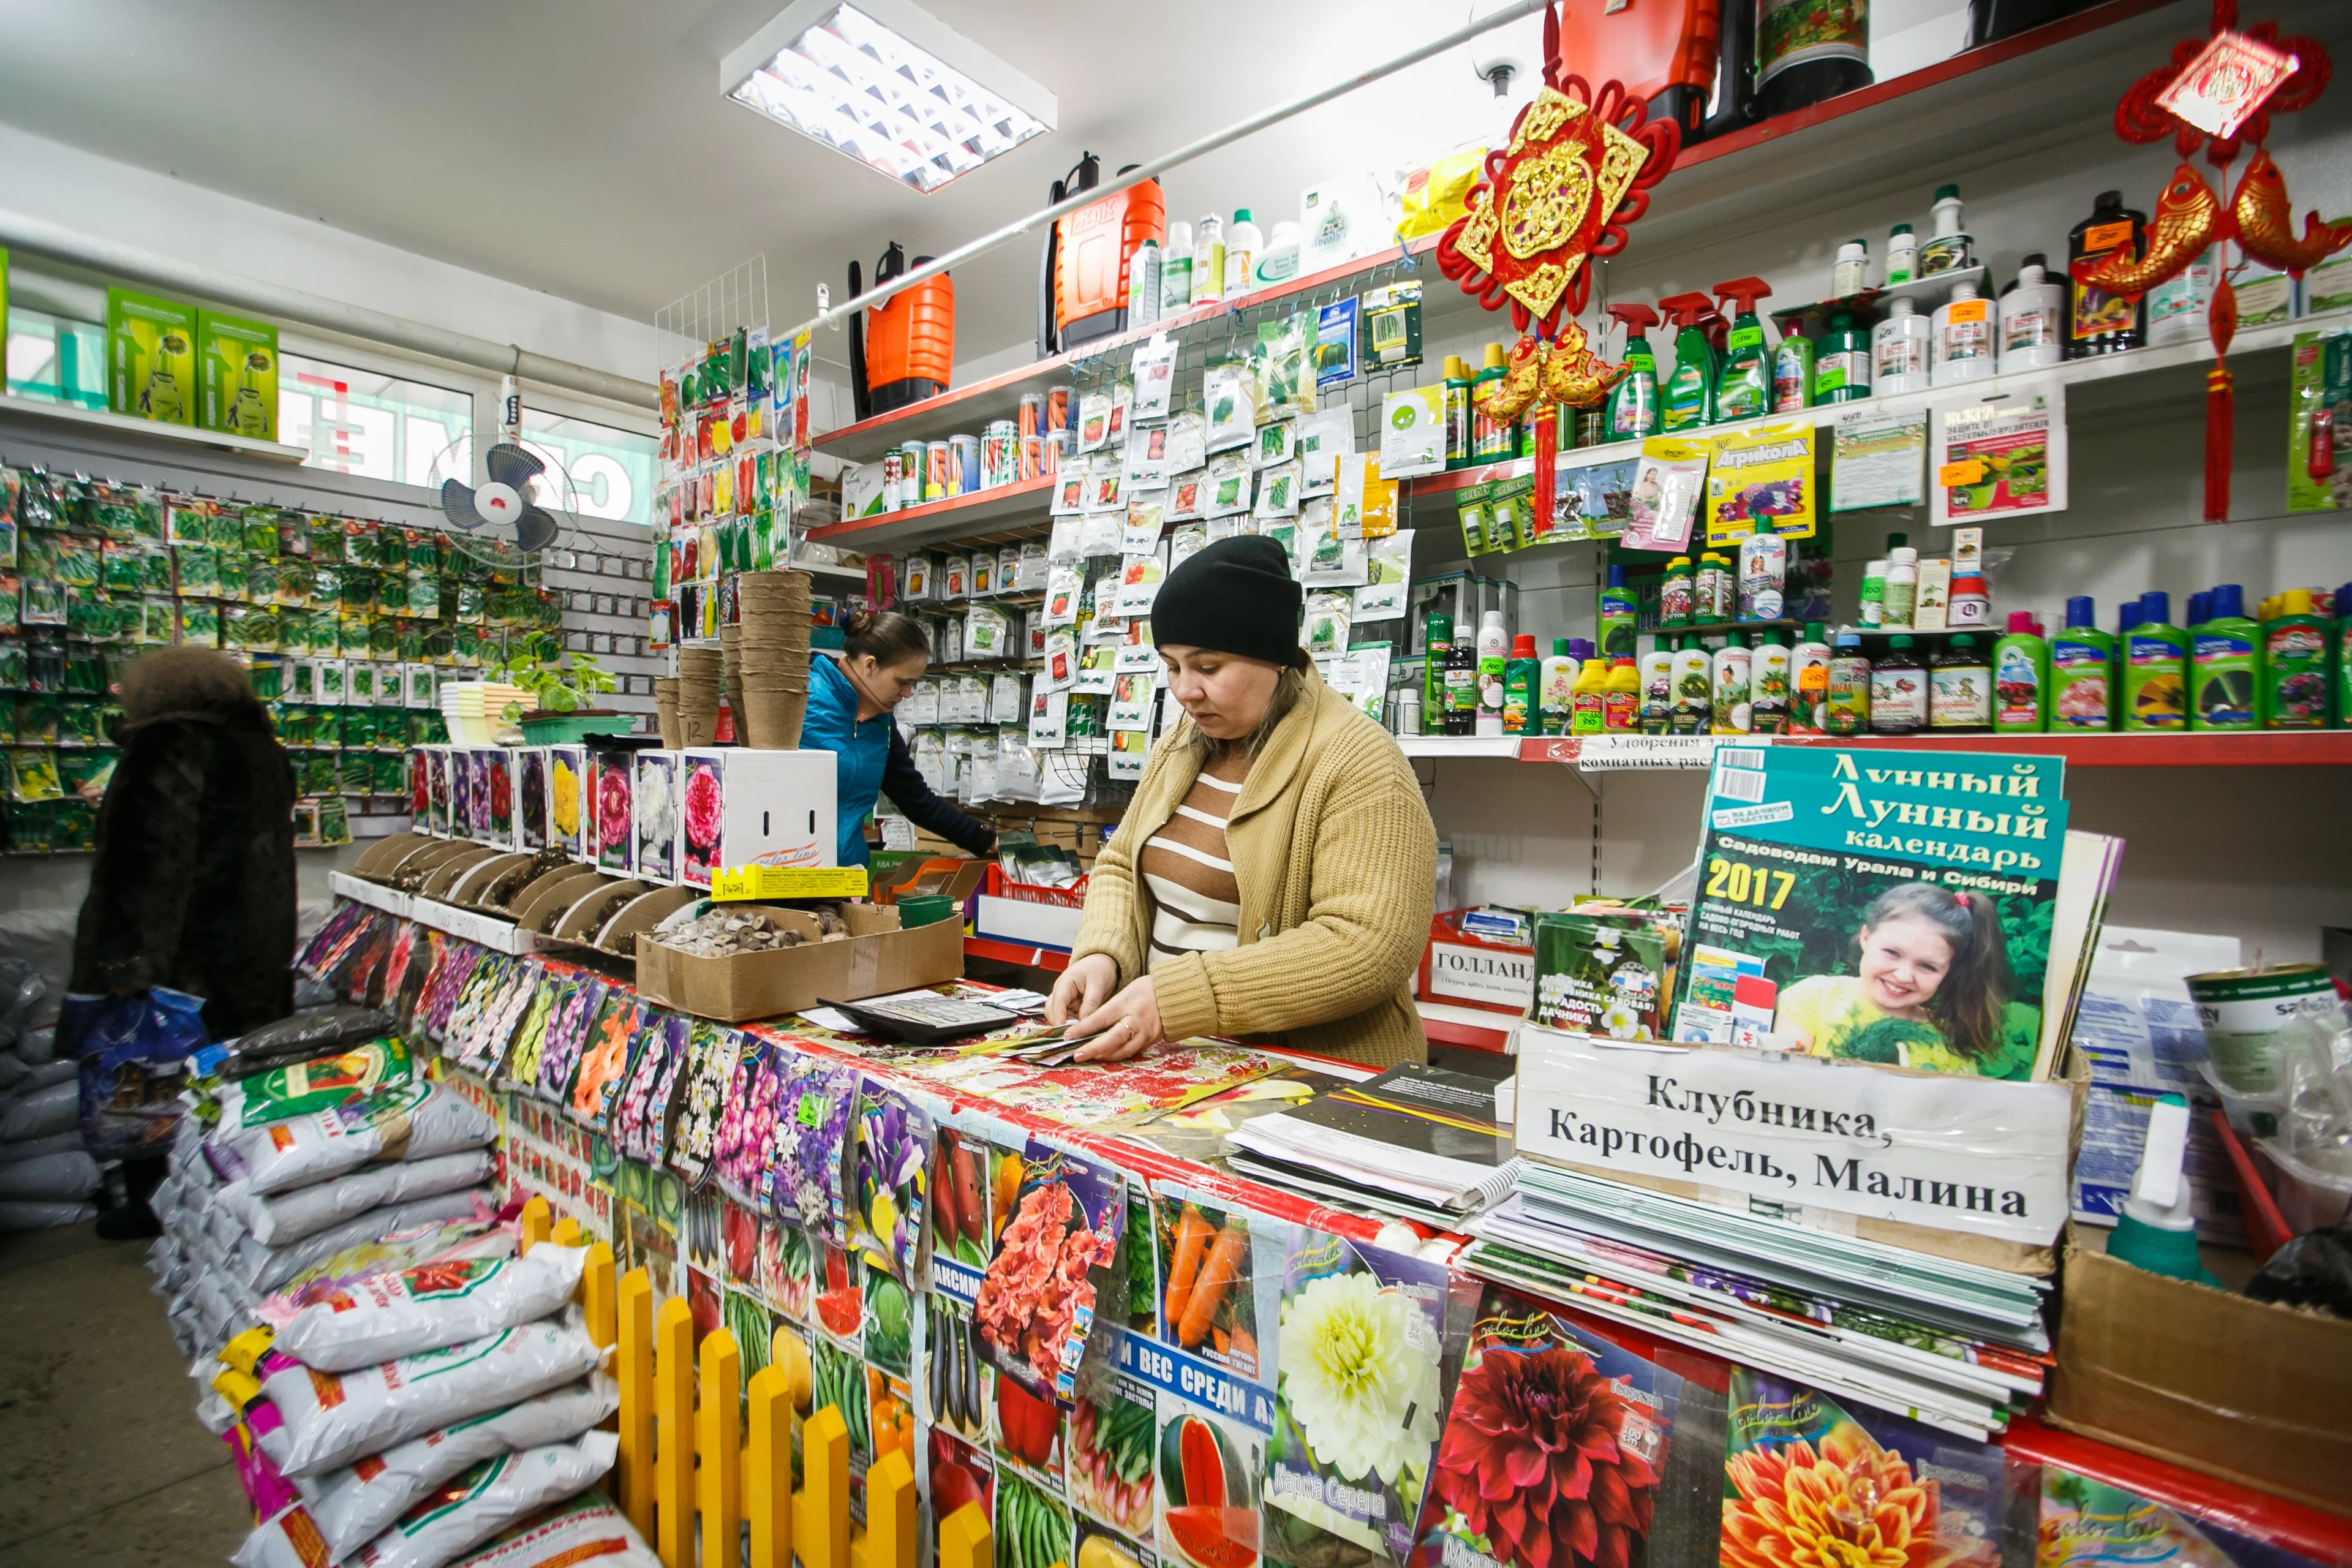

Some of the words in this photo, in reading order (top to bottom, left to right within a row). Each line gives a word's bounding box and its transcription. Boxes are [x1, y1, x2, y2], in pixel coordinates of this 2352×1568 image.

[1493, 478, 1531, 497] КРЕПЕНЬ
[687, 721, 705, 742] 12
[1610, 736, 1700, 751] Удобрения
[1581, 756, 1673, 767] комнатных
[1821, 782, 2049, 840] Лунный
[1845, 830, 2042, 870] календарь
[1717, 836, 1838, 868] Садоводам
[1844, 857, 1915, 880] Урала
[1920, 870, 1937, 882] и
[1944, 871, 2037, 897] Сибири
[1705, 858, 1796, 910] 2017
[1709, 923, 1728, 935] ВЕСЬ
[1728, 927, 1745, 939] ГОД
[1776, 928, 1801, 940] РАБОТ
[1539, 1005, 1593, 1025] ДАЧНИКА
[1645, 1072, 1894, 1148] Клубника,
[1547, 1106, 1797, 1189] Картофель,
[1813, 1151, 2029, 1218] Малина
[1201, 1345, 1231, 1365] РУССКИЙ
[1232, 1357, 1256, 1376] ГИГАНТ
[1120, 1340, 1132, 1366] И
[1139, 1346, 1174, 1384] ВЕС
[1180, 1364, 1246, 1417] СРЕДИ
[1610, 1378, 1664, 1410] Георгина
[1124, 1389, 1155, 1412] ЗАСТОЛЬЕ
[1737, 1392, 1784, 1429] color
[1789, 1392, 1820, 1422] line
[1623, 1434, 1638, 1447] cm
[1624, 1425, 1642, 1439] 100
[1274, 1461, 1324, 1503] Карма
[1326, 1476, 1387, 1520] Серена
